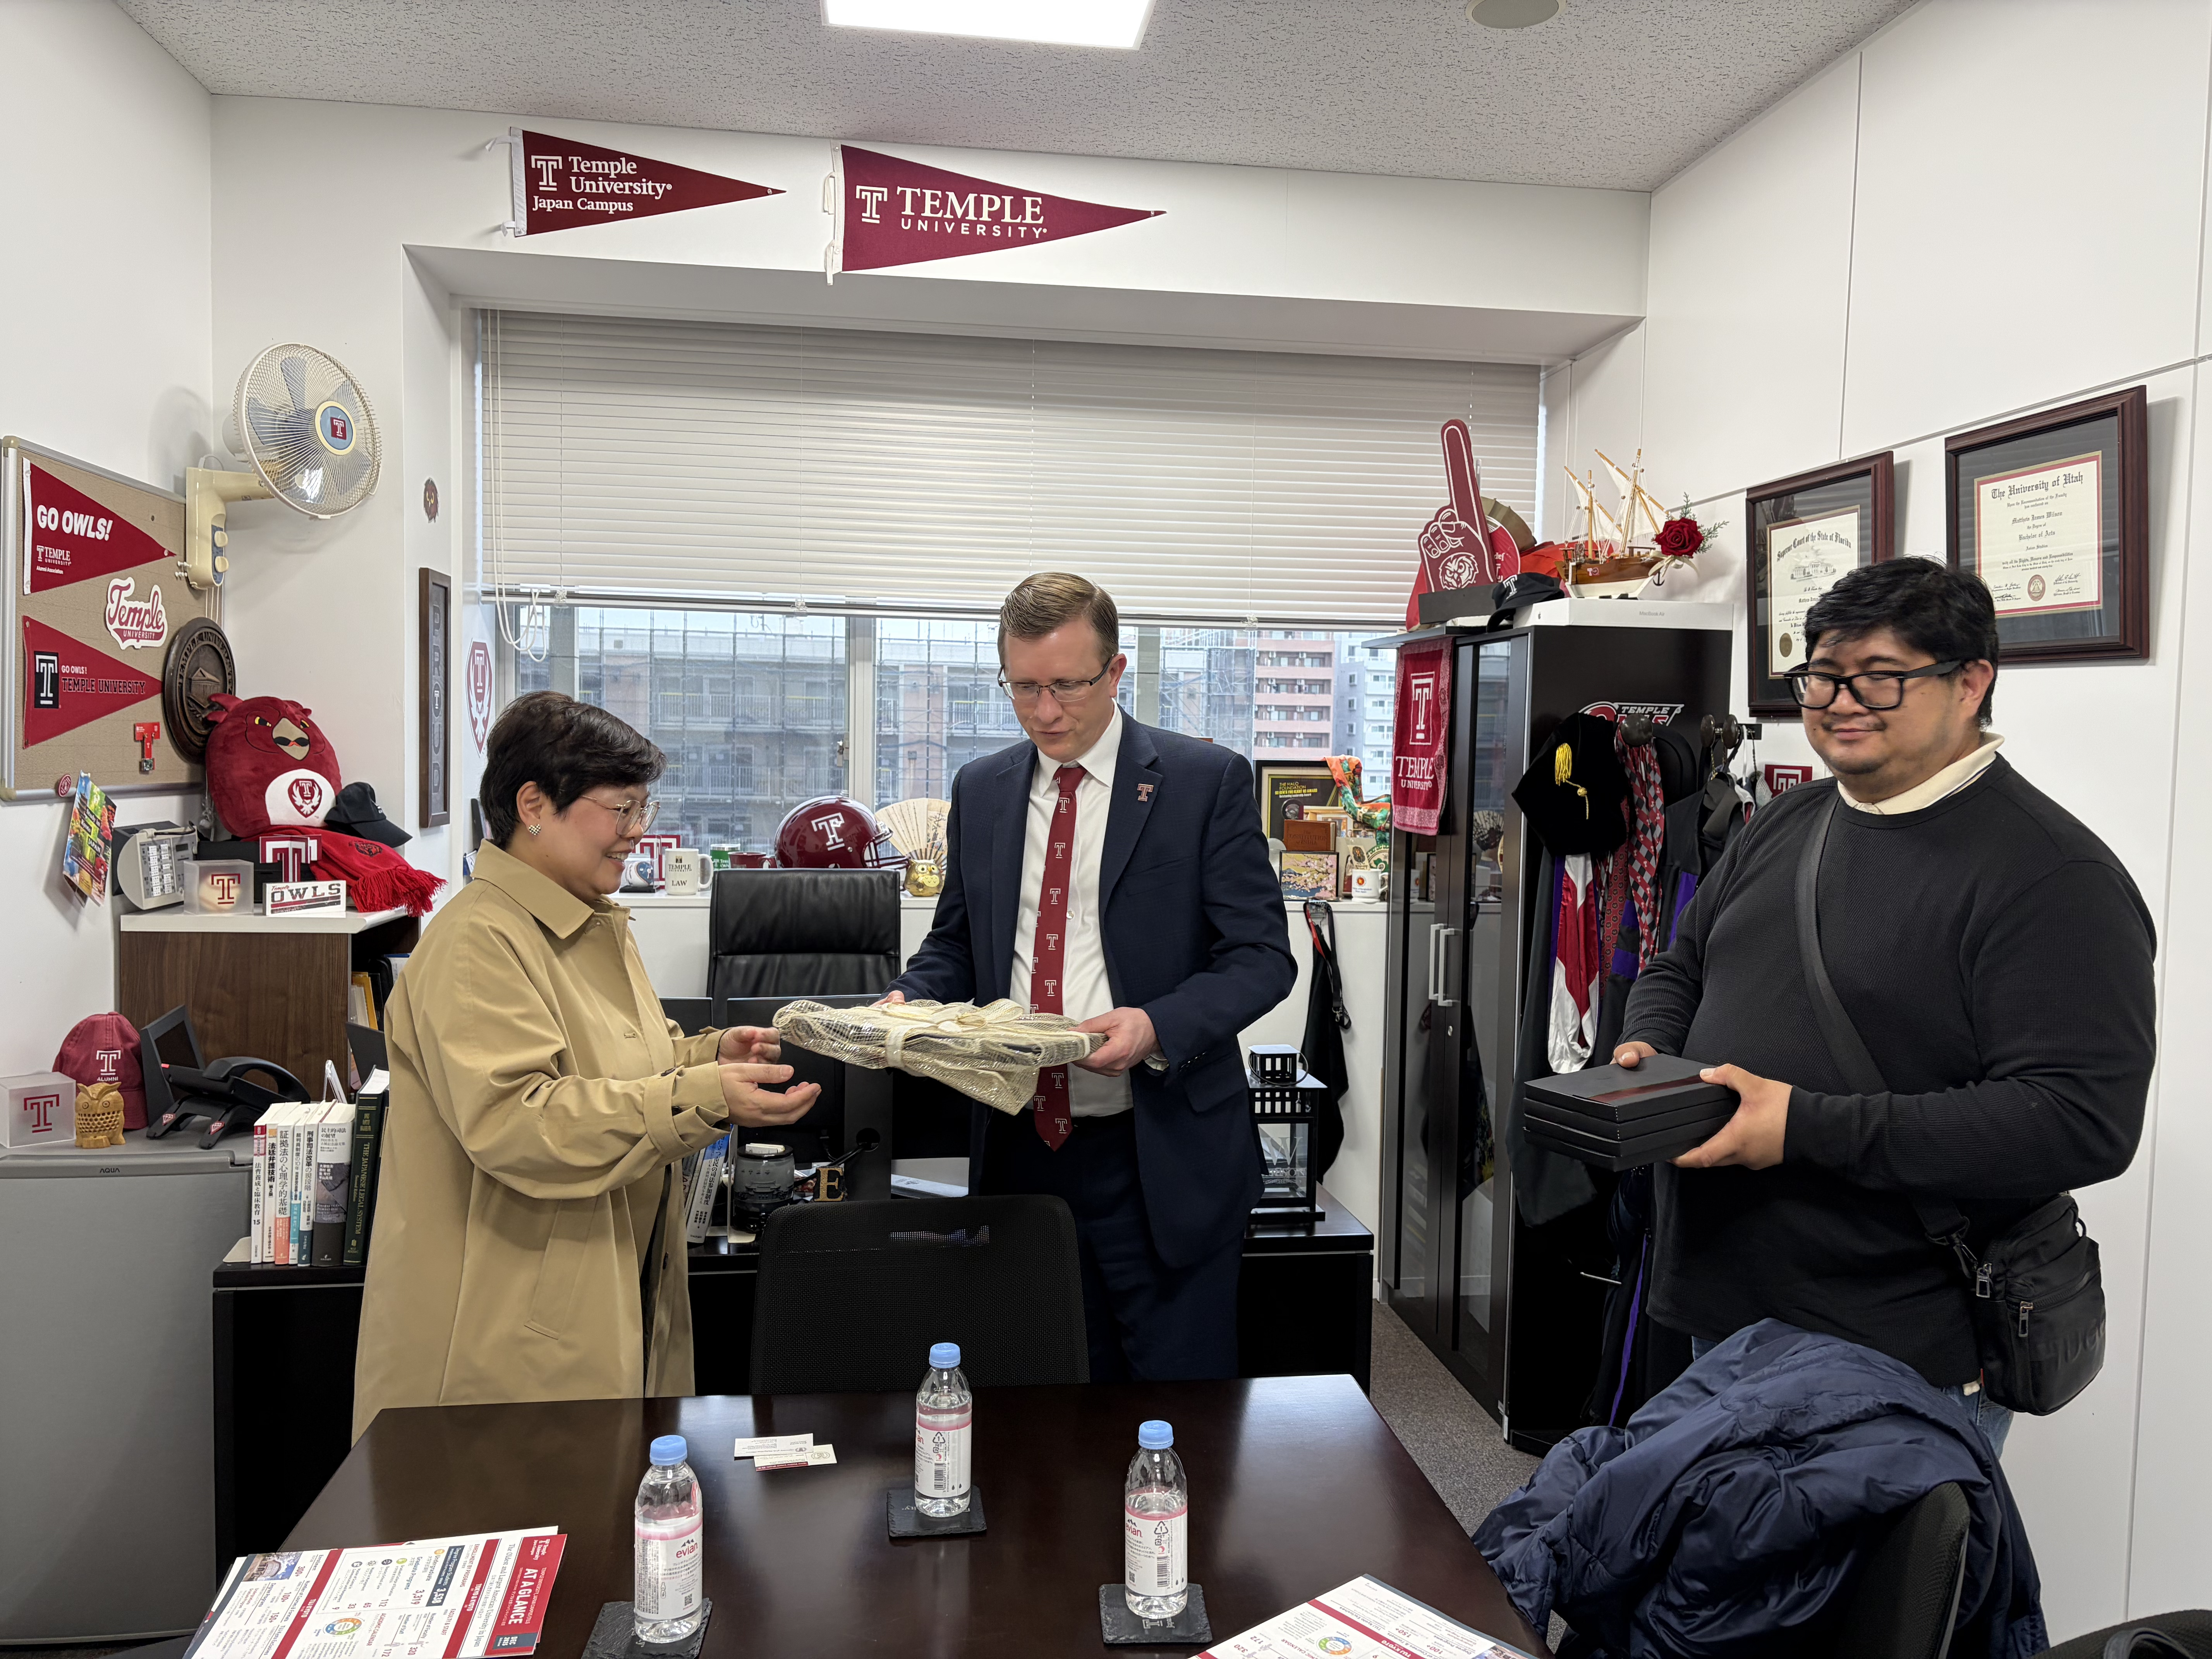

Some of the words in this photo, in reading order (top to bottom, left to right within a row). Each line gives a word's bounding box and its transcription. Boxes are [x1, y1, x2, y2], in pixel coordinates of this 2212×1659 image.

[531, 155, 563, 191] T
[568, 156, 637, 178] Temple
[570, 177, 666, 199] University
[532, 196, 574, 212] Japan
[577, 198, 633, 214] Campus
[856, 185, 888, 224] T
[896, 186, 1044, 224] TEMPLE
[901, 218, 1043, 239] UNIVERSITY
[1991, 488, 2005, 500] The
[2008, 480, 2049, 499] University
[2052, 476, 2060, 487] of
[2063, 471, 2083, 488] Utah
[37, 505, 59, 531] GO
[62, 510, 113, 541] OWLS!
[2019, 532, 2037, 542] Bachelor
[2045, 530, 2056, 538] Arts
[36, 545, 44, 562] T
[45, 546, 70, 560] TEMPLE
[1777, 544, 1792, 562] Supreme
[1793, 536, 1805, 548] Court
[1806, 534, 1810, 543] of
[1817, 531, 1828, 541] State
[1829, 533, 1834, 541] of
[1835, 532, 1851, 548] Florida
[108, 583, 165, 631] Temple
[123, 630, 155, 639] UNIVERSITY
[71, 666, 87, 674] OWLS!
[36, 655, 57, 704] T
[62, 677, 95, 693] TEMPLE
[98, 678, 145, 694] UNIVERSITY
[1396, 756, 1434, 779] TEMPLE
[811, 812, 845, 851] T
[88, 838, 101, 853] JAPAN
[211, 873, 240, 904] T
[271, 883, 341, 903] OWLS
[96, 1050, 121, 1075] T
[268, 1143, 276, 1183] 法廷弁護技術
[278, 1130, 289, 1215] 証拠法の心理学的基礎
[1126, 1523, 1142, 1537] evian
[451, 1547, 462, 1558] Degree
[467, 1544, 480, 1565] ENROLLMENT
[532, 1544, 543, 1560] University
[539, 1544, 549, 1556] Temple
[676, 1542, 698, 1558] evian
[311, 1554, 324, 1571] Enrollment
[410, 1556, 423, 1573] Graduate
[446, 1558, 457, 1572] Program
[502, 1552, 513, 1565] Oldest
[292, 1566, 306, 1577] 300+
[424, 1555, 441, 1581] Undergraduate
[522, 1568, 539, 1580] AT
[539, 1567, 547, 1578] TEMPLE
[300, 1580, 310, 1592] Number
[402, 1573, 416, 1590] Programs
[442, 1572, 452, 1586] Students
[459, 1570, 471, 1587] PROGRAMS
[493, 1575, 505, 1589] Largest
[519, 1580, 535, 1589] A
[278, 1592, 292, 1602] 100+
[408, 1589, 425, 1605] 3,319
[429, 1588, 447, 1604] 3,538
[472, 1583, 482, 1596] TOKYO
[378, 1599, 389, 1607] 112
[466, 1599, 476, 1611] KYOTO
[487, 1590, 500, 1609] American
[508, 1589, 532, 1624] GLANCE
[266, 1612, 280, 1623] 150+
[300, 1606, 313, 1618] KYOTO
[445, 1609, 456, 1622] FACULTY
[527, 1604, 535, 1616] CAMPUS
[374, 1613, 387, 1628] ACADEMIC
[403, 1614, 412, 1625] Number
[427, 1613, 436, 1624] Number
[478, 1609, 493, 1630] University
[366, 1629, 379, 1646] CALENDAR
[420, 1628, 430, 1638] Faculty
[440, 1625, 449, 1635] STAFF
[1393, 1627, 1413, 1638] 150+
[472, 1635, 484, 1647] Japan
[508, 1636, 518, 1645] DEC
[1249, 1635, 1264, 1644] 172
[1279, 1638, 1307, 1654] CALENDAR
[1379, 1639, 1402, 1652] KYOTO
[381, 1649, 392, 1657] 172
[407, 1647, 418, 1655] 320
[1398, 1649, 1413, 1657] TUJ
[1424, 1644, 1444, 1655] 100+
